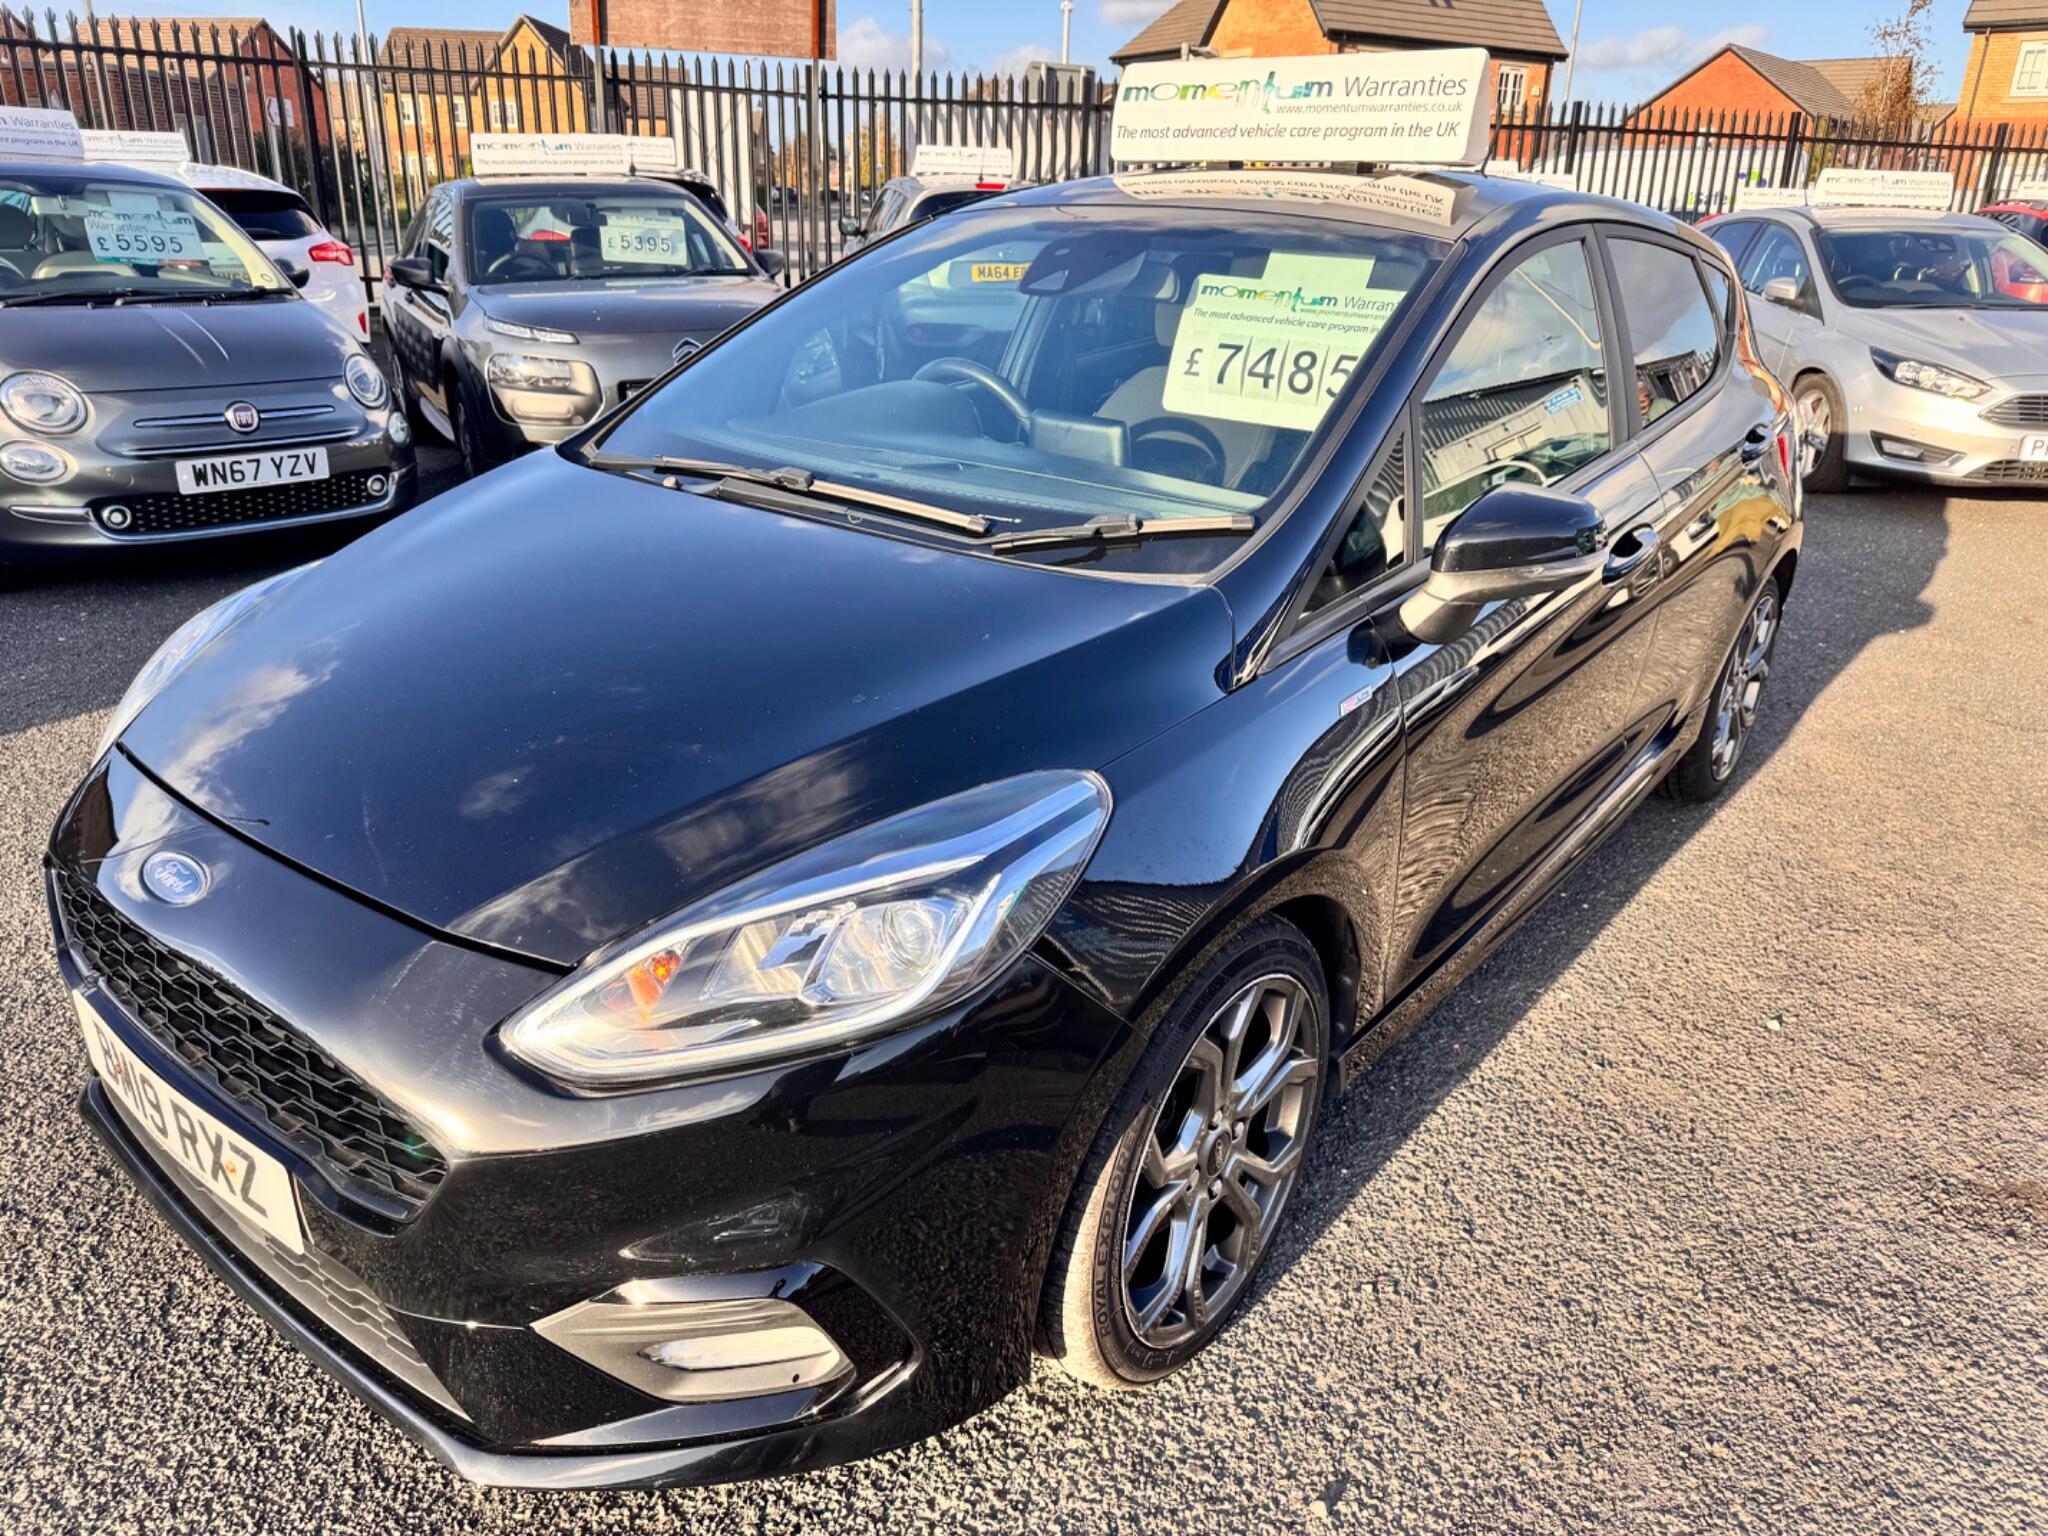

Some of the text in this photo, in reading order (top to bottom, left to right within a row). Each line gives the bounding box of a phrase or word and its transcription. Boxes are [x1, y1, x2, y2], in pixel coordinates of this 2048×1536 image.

[1123, 71, 1468, 113] momentum Warranties
[1276, 102, 1462, 114] www.momentumwarranties.co.uk
[9, 117, 74, 130] Warranties
[1117, 121, 1461, 141] The most advanced vehicle care program in the UK
[86, 218, 148, 232] Warranties
[88, 208, 192, 229] momentum
[978, 266, 1009, 279] MA64
[1200, 285, 1338, 312] momentum
[1194, 308, 1208, 318] The
[1208, 310, 1230, 320] most
[1230, 312, 1273, 325] advanced
[1275, 316, 1304, 328] vehicle
[1306, 320, 1327, 329] care
[1328, 322, 1368, 334] program
[191, 452, 316, 487] WN67 YZV
[155, 861, 193, 893] Ford
[169, 1097, 269, 1220] RXZ
[1095, 1272, 1111, 1339] ROYAL
